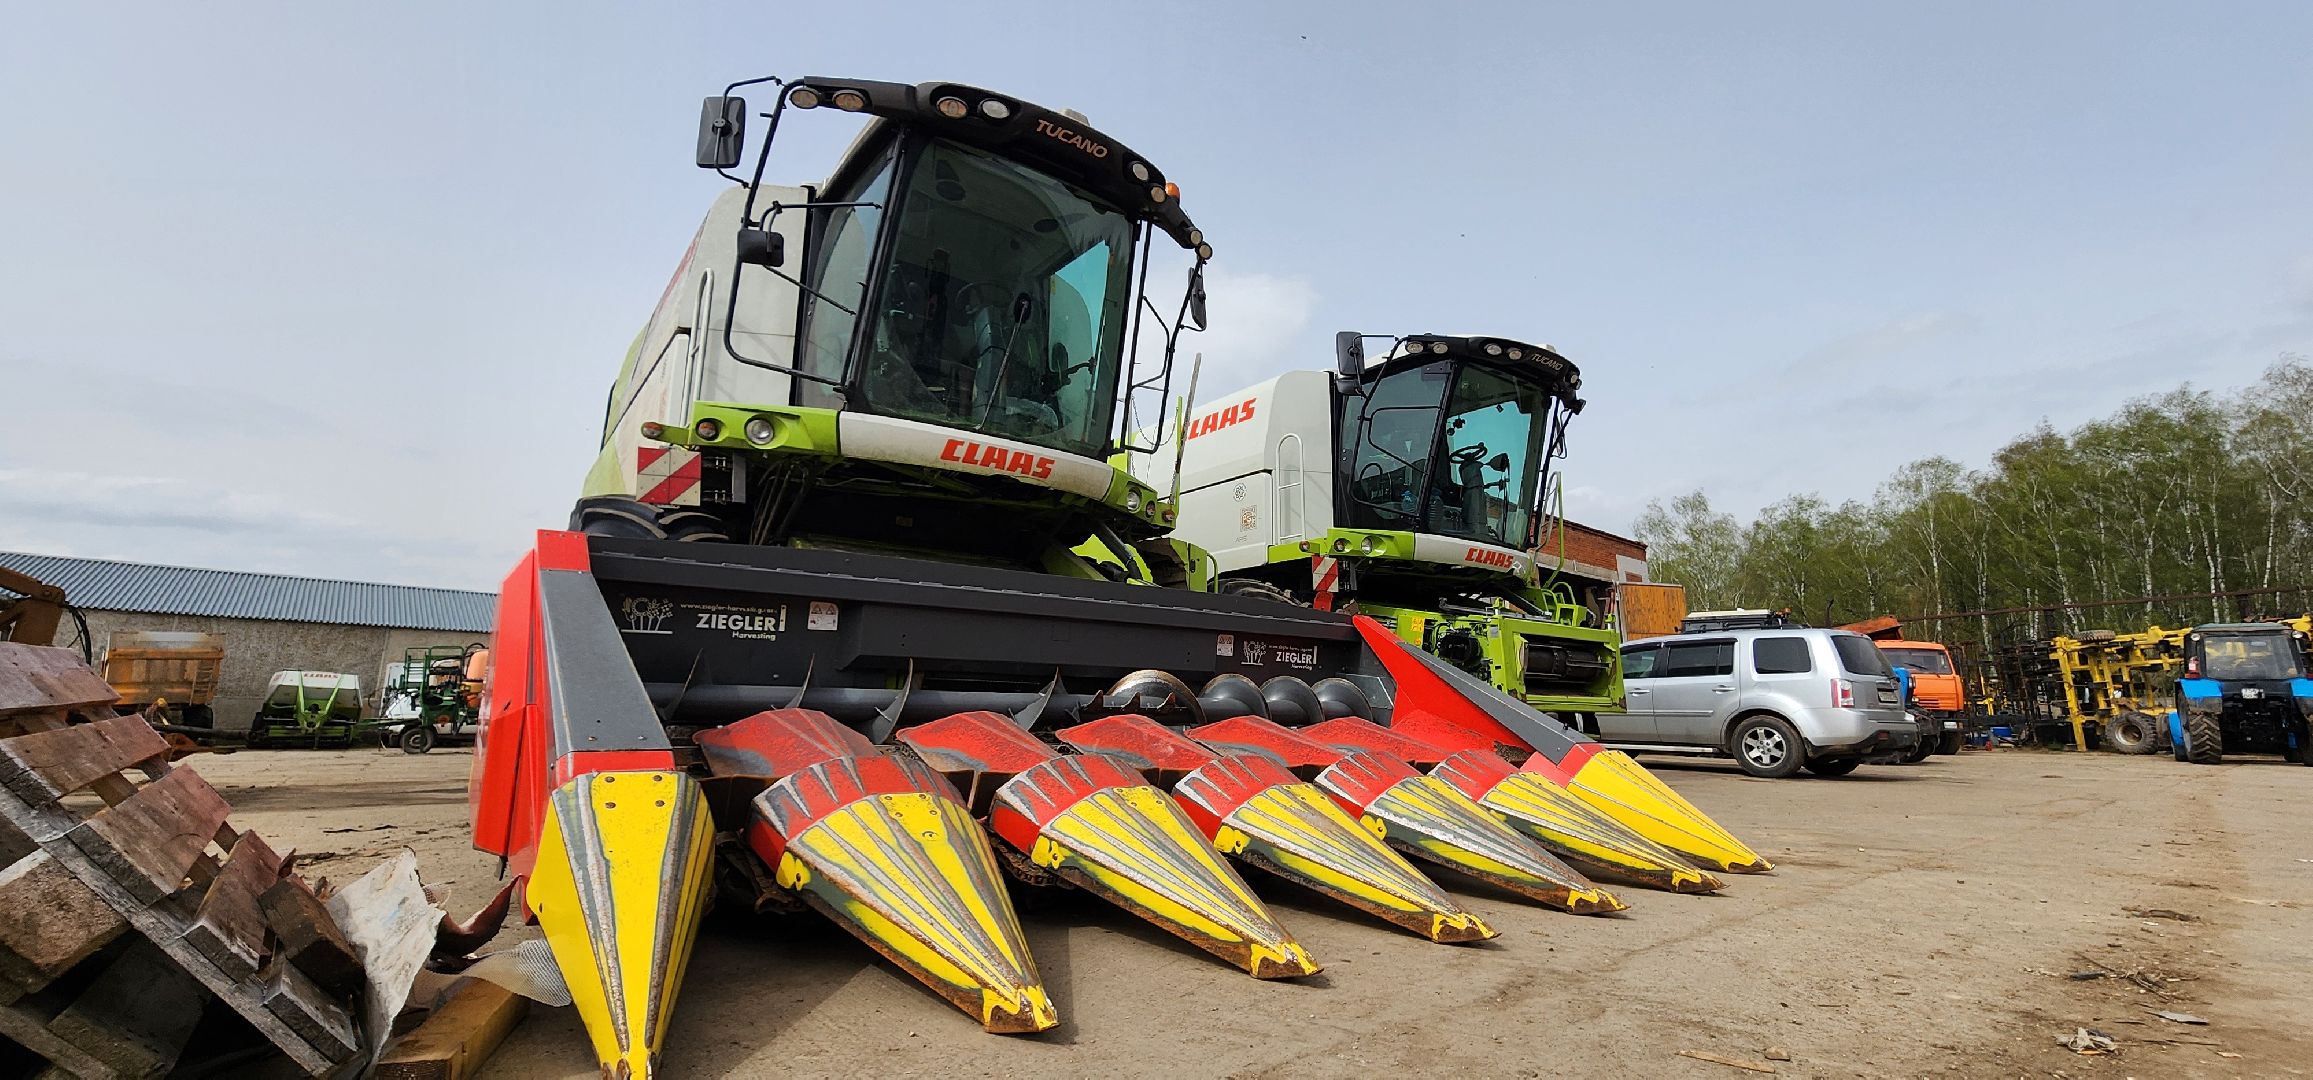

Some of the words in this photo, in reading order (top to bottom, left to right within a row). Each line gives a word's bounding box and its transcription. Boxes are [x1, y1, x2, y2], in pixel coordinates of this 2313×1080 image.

[1036, 119, 1108, 158] TUCANO
[1531, 353, 1564, 371] TUCANO
[1182, 398, 1257, 440] LAAS
[940, 438, 1056, 480] CLAAS
[1465, 547, 1514, 569] CLAAS
[696, 613, 776, 631] ZIEGLER
[732, 631, 776, 641] Harvesting
[1275, 652, 1312, 664] ZIEGLER
